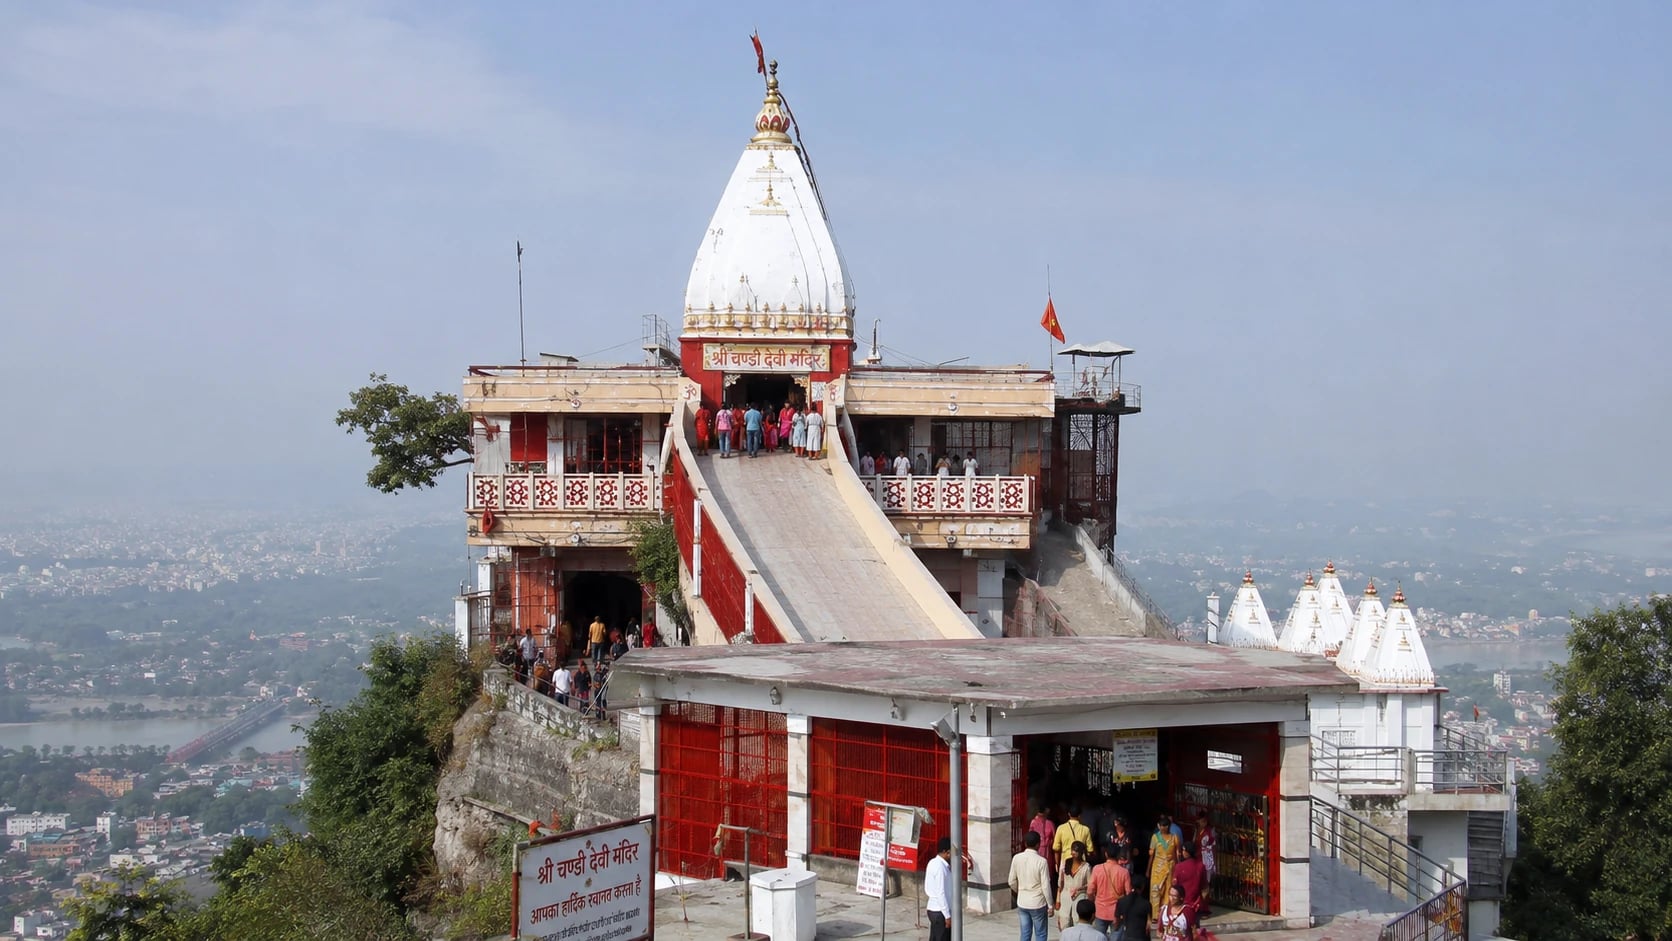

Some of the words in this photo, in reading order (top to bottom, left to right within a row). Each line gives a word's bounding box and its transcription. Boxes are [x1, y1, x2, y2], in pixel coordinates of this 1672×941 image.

[712, 347, 728, 366] श्री
[731, 347, 761, 367] चण्डी
[764, 347, 786, 369] देवी
[790, 348, 823, 369] मंदिर
[537, 857, 554, 884] श्री
[557, 850, 586, 879] चण्डी
[589, 844, 610, 873] देवी
[612, 839, 640, 865] मंदिर
[530, 903, 559, 924] आपका
[561, 892, 586, 916] हार्दिक
